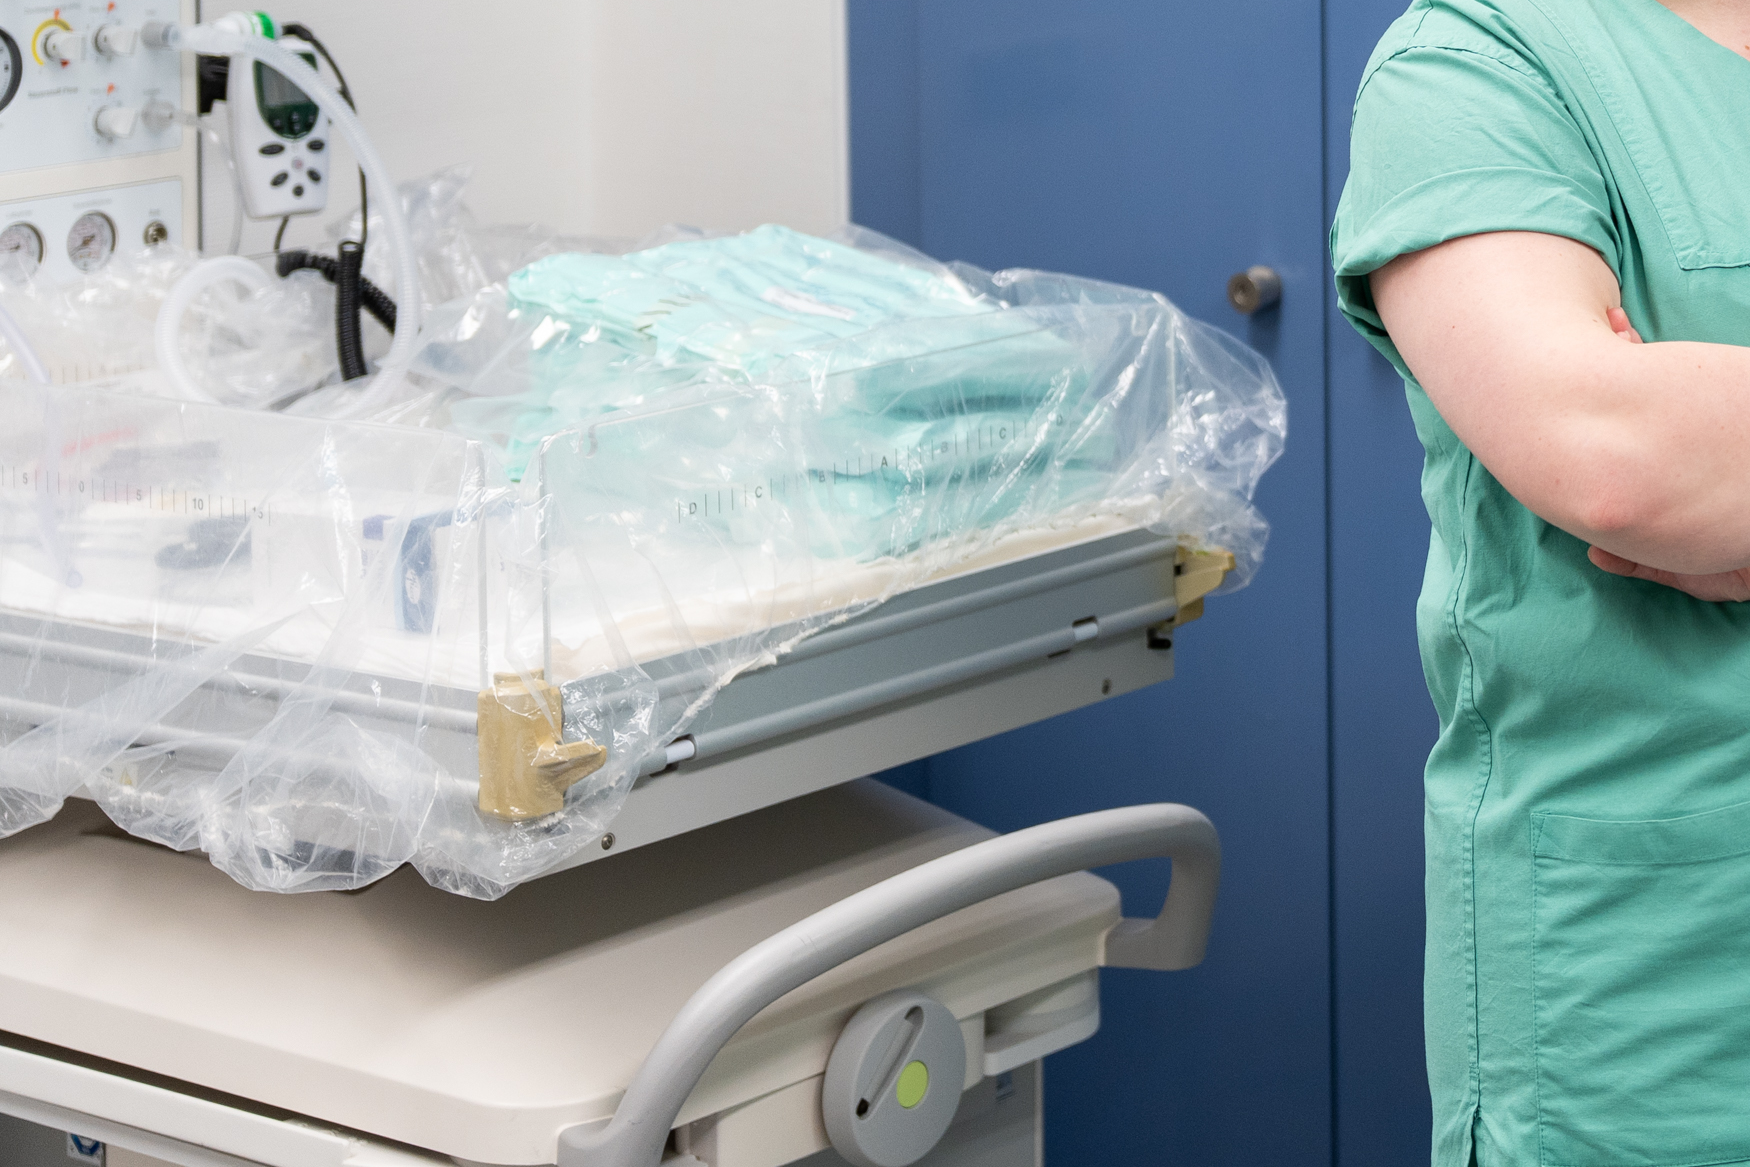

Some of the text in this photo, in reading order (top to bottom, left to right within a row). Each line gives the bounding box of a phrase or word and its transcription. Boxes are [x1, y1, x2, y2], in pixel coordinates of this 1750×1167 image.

[754, 486, 763, 498] C
[881, 456, 889, 467] A
[998, 428, 1007, 439] C
[78, 480, 85, 492] 0
[136, 489, 142, 501] 5
[192, 497, 204, 510] 10
